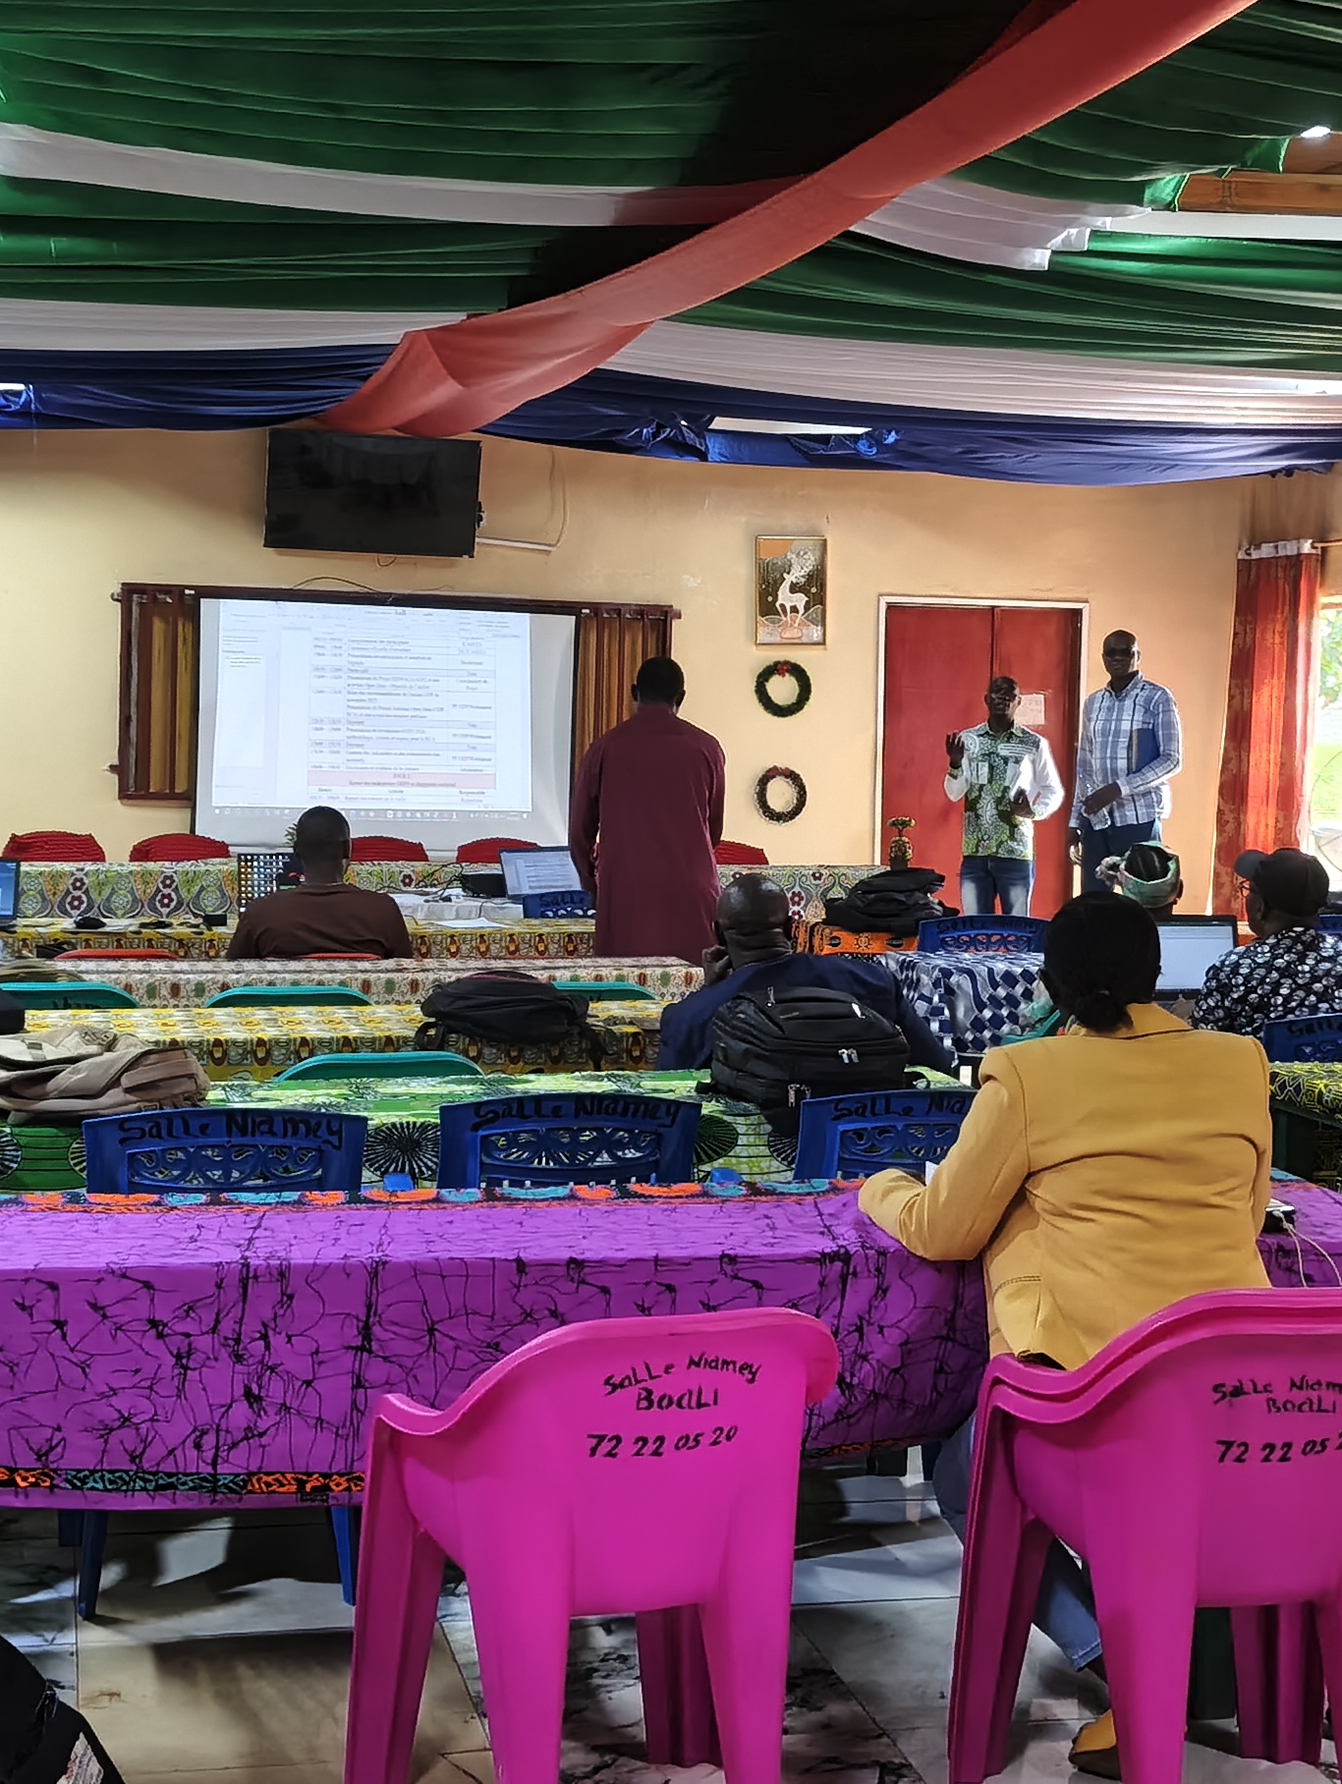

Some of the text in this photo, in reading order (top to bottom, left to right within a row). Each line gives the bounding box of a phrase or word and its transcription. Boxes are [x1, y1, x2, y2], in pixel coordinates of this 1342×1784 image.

[586, 1424, 739, 1459] 72 22 05 20
[1215, 1439, 1250, 1464] 72
[1260, 1441, 1294, 1463] 22
[1300, 1437, 1332, 1457] 05
